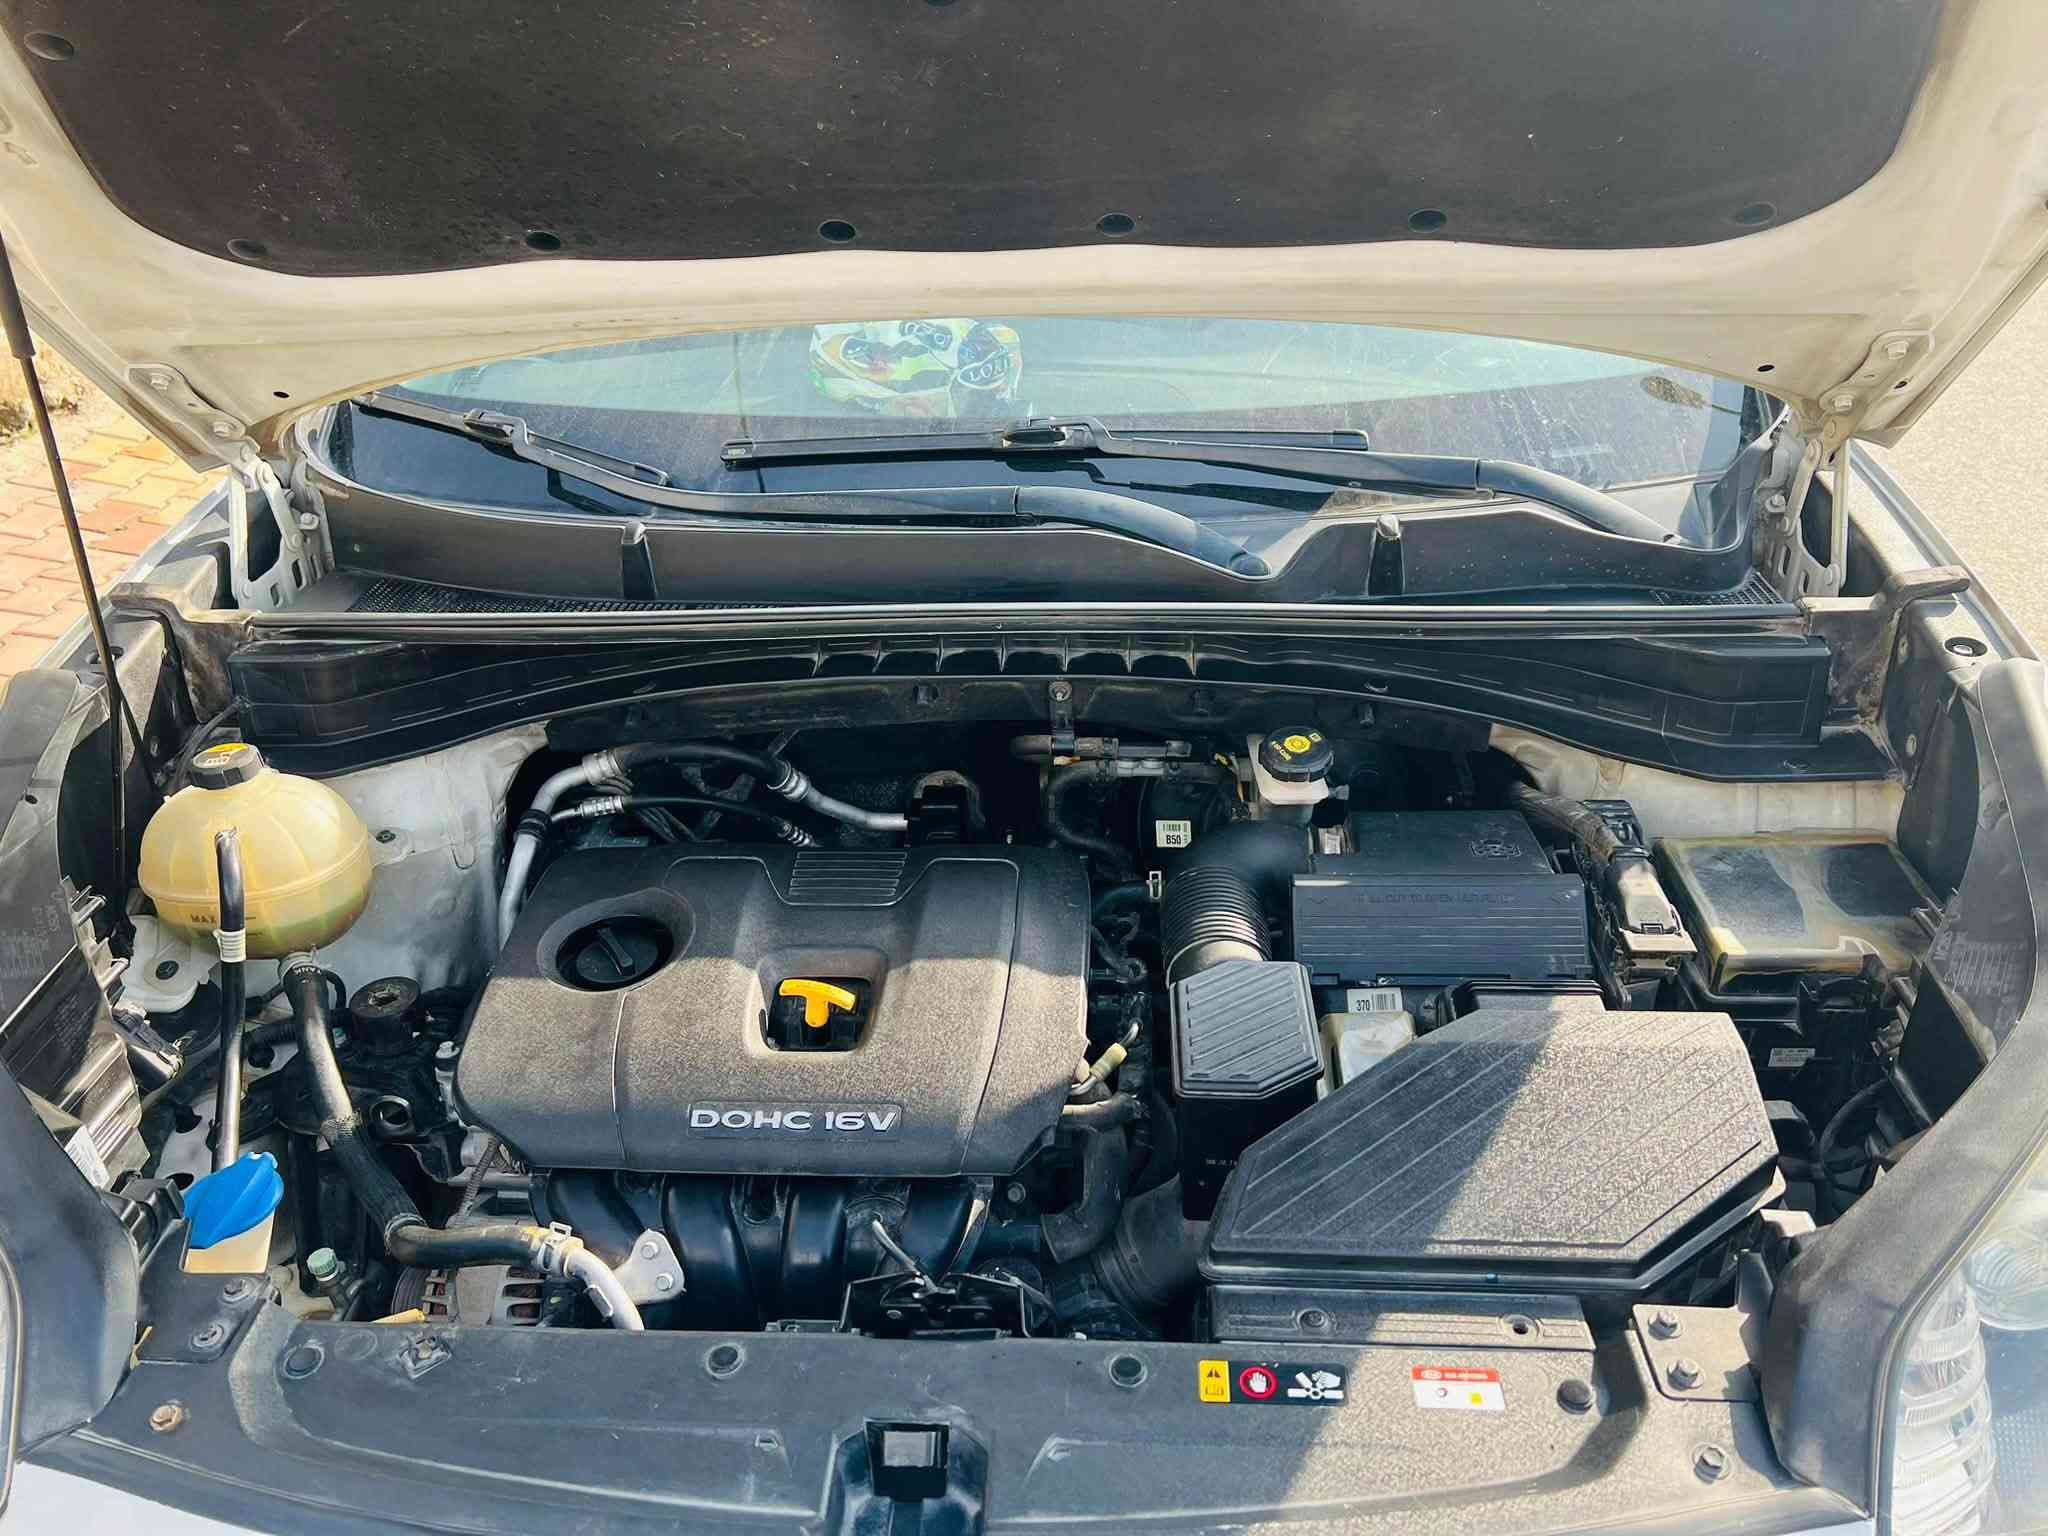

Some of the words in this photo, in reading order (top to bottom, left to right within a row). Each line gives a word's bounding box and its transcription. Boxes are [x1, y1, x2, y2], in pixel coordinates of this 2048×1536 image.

[1356, 999, 1370, 1012] 370
[689, 1109, 813, 1131] DOHC
[824, 1110, 897, 1132] 16V
